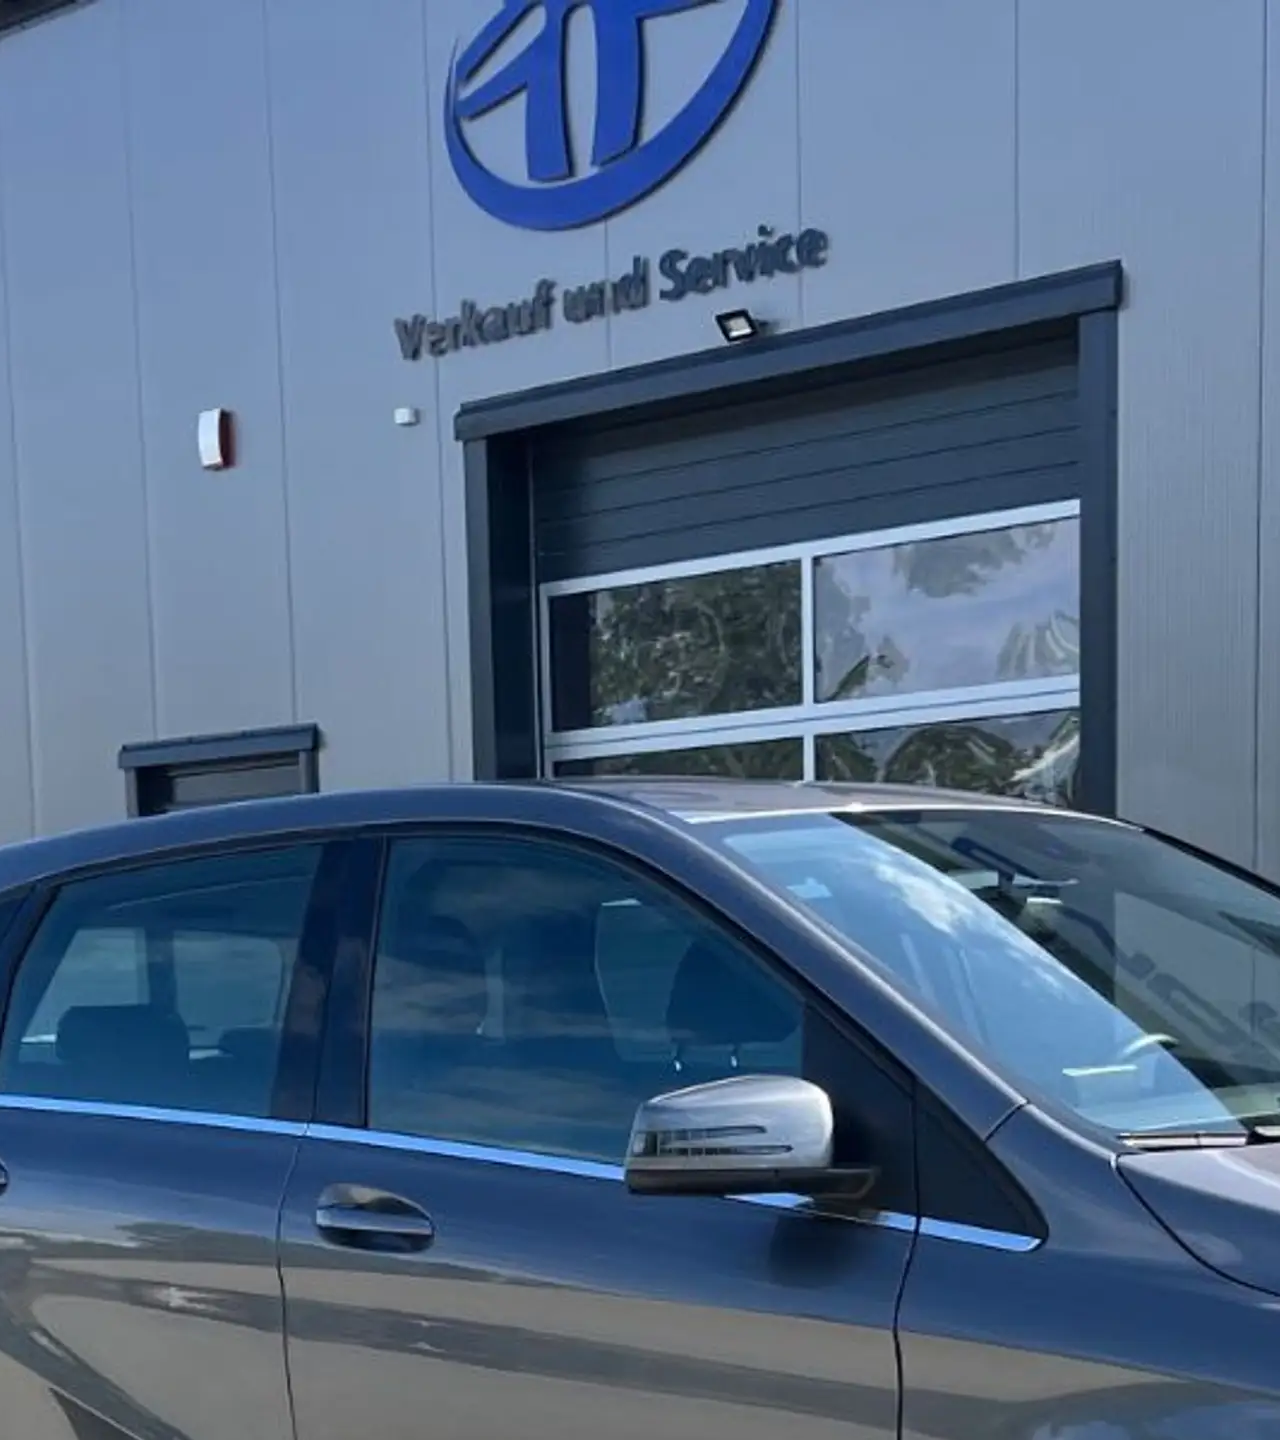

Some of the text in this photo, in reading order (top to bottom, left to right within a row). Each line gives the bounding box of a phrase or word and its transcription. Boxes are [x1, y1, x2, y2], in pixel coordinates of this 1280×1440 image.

[394, 226, 828, 360] Verkauf und Service
